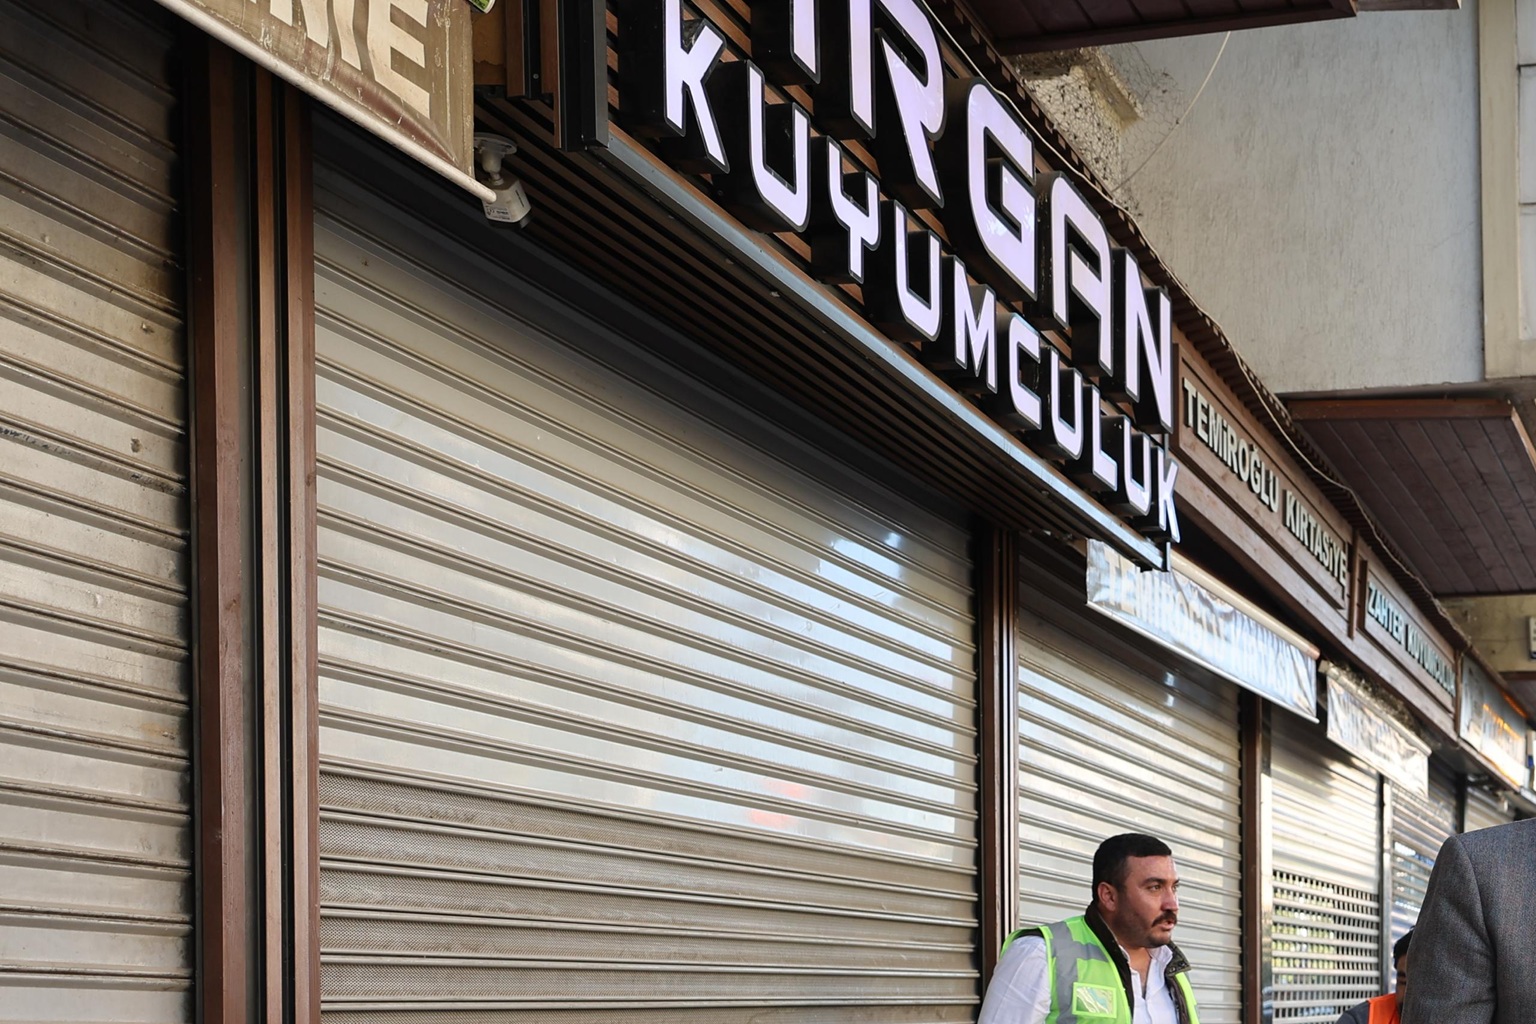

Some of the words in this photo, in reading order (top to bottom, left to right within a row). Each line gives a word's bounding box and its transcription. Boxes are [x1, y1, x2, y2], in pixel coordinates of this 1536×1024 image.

[664, 0, 1181, 544] KUYUMCULUK
[1183, 377, 1280, 513] TEMİROĞLU
[1284, 489, 1348, 586] KIRTASİYE
